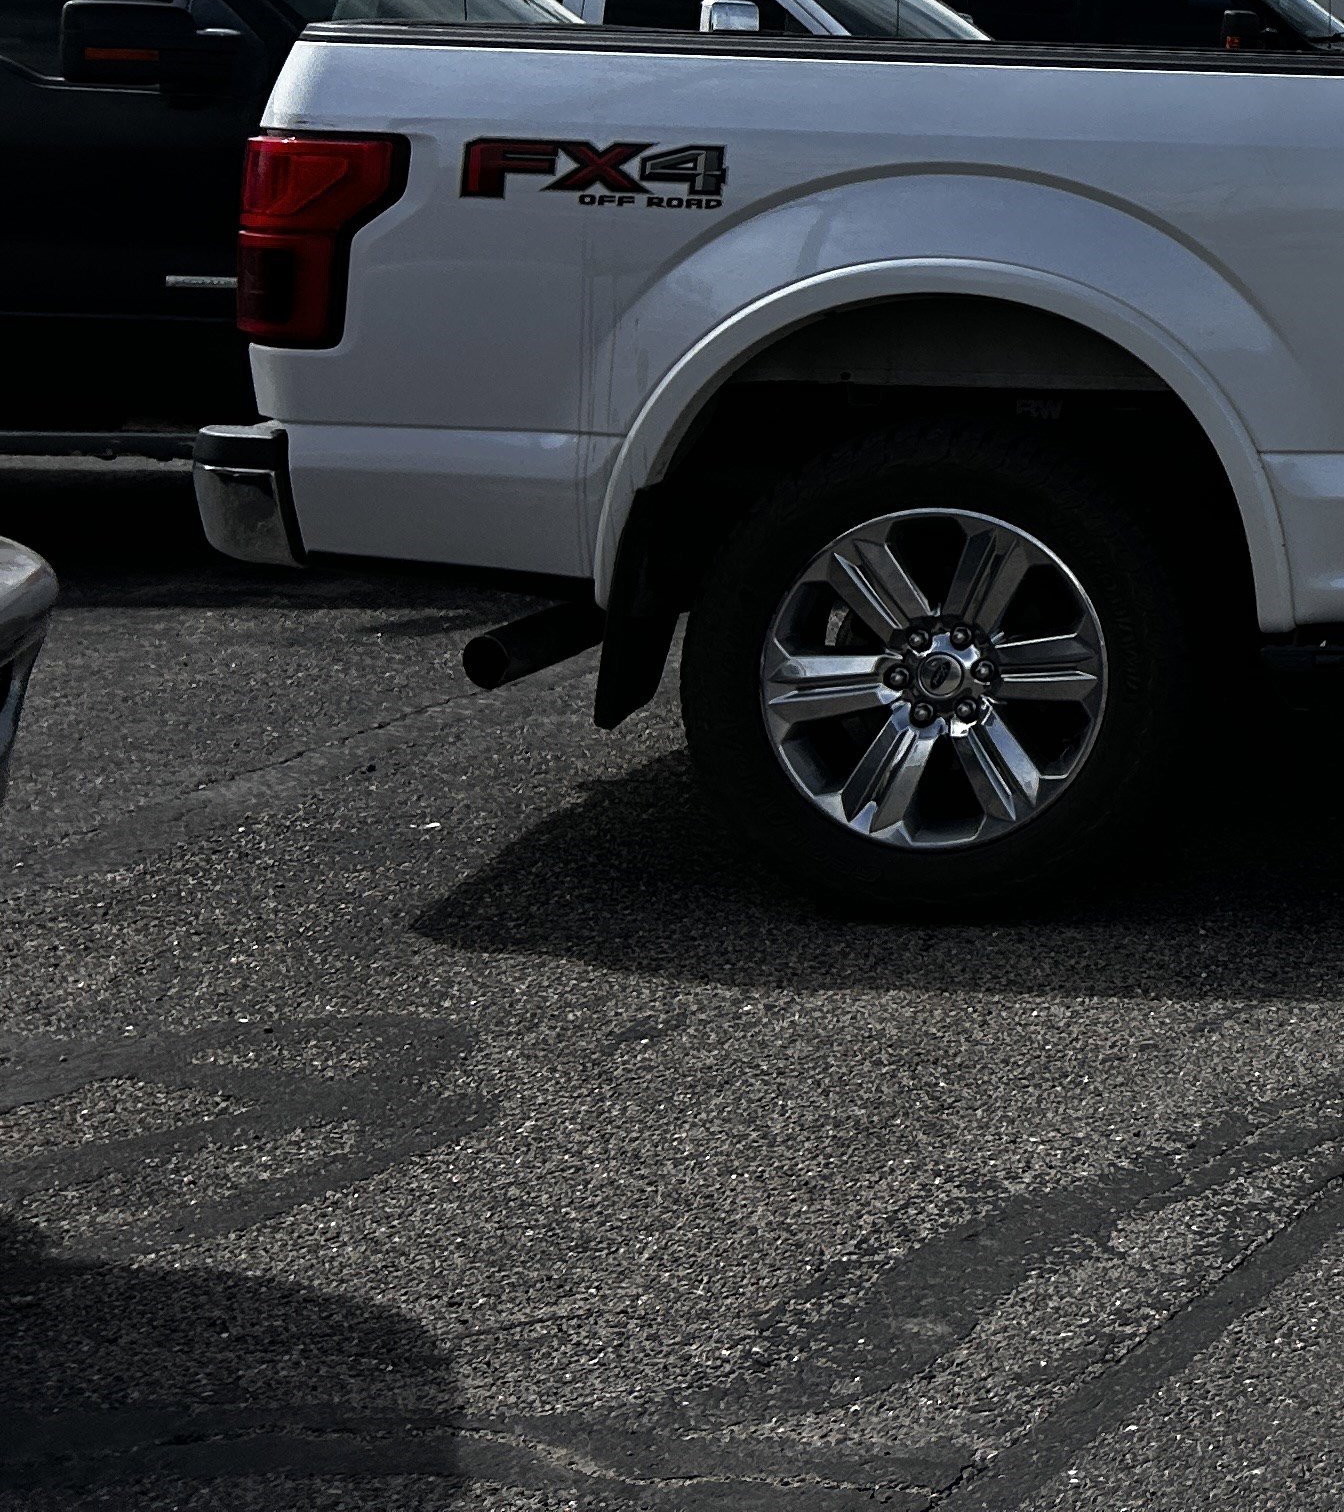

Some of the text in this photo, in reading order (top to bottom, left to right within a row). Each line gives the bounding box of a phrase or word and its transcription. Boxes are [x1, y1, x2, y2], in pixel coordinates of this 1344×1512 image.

[458, 136, 729, 199] FX4
[578, 193, 724, 209] OFF ROAD
